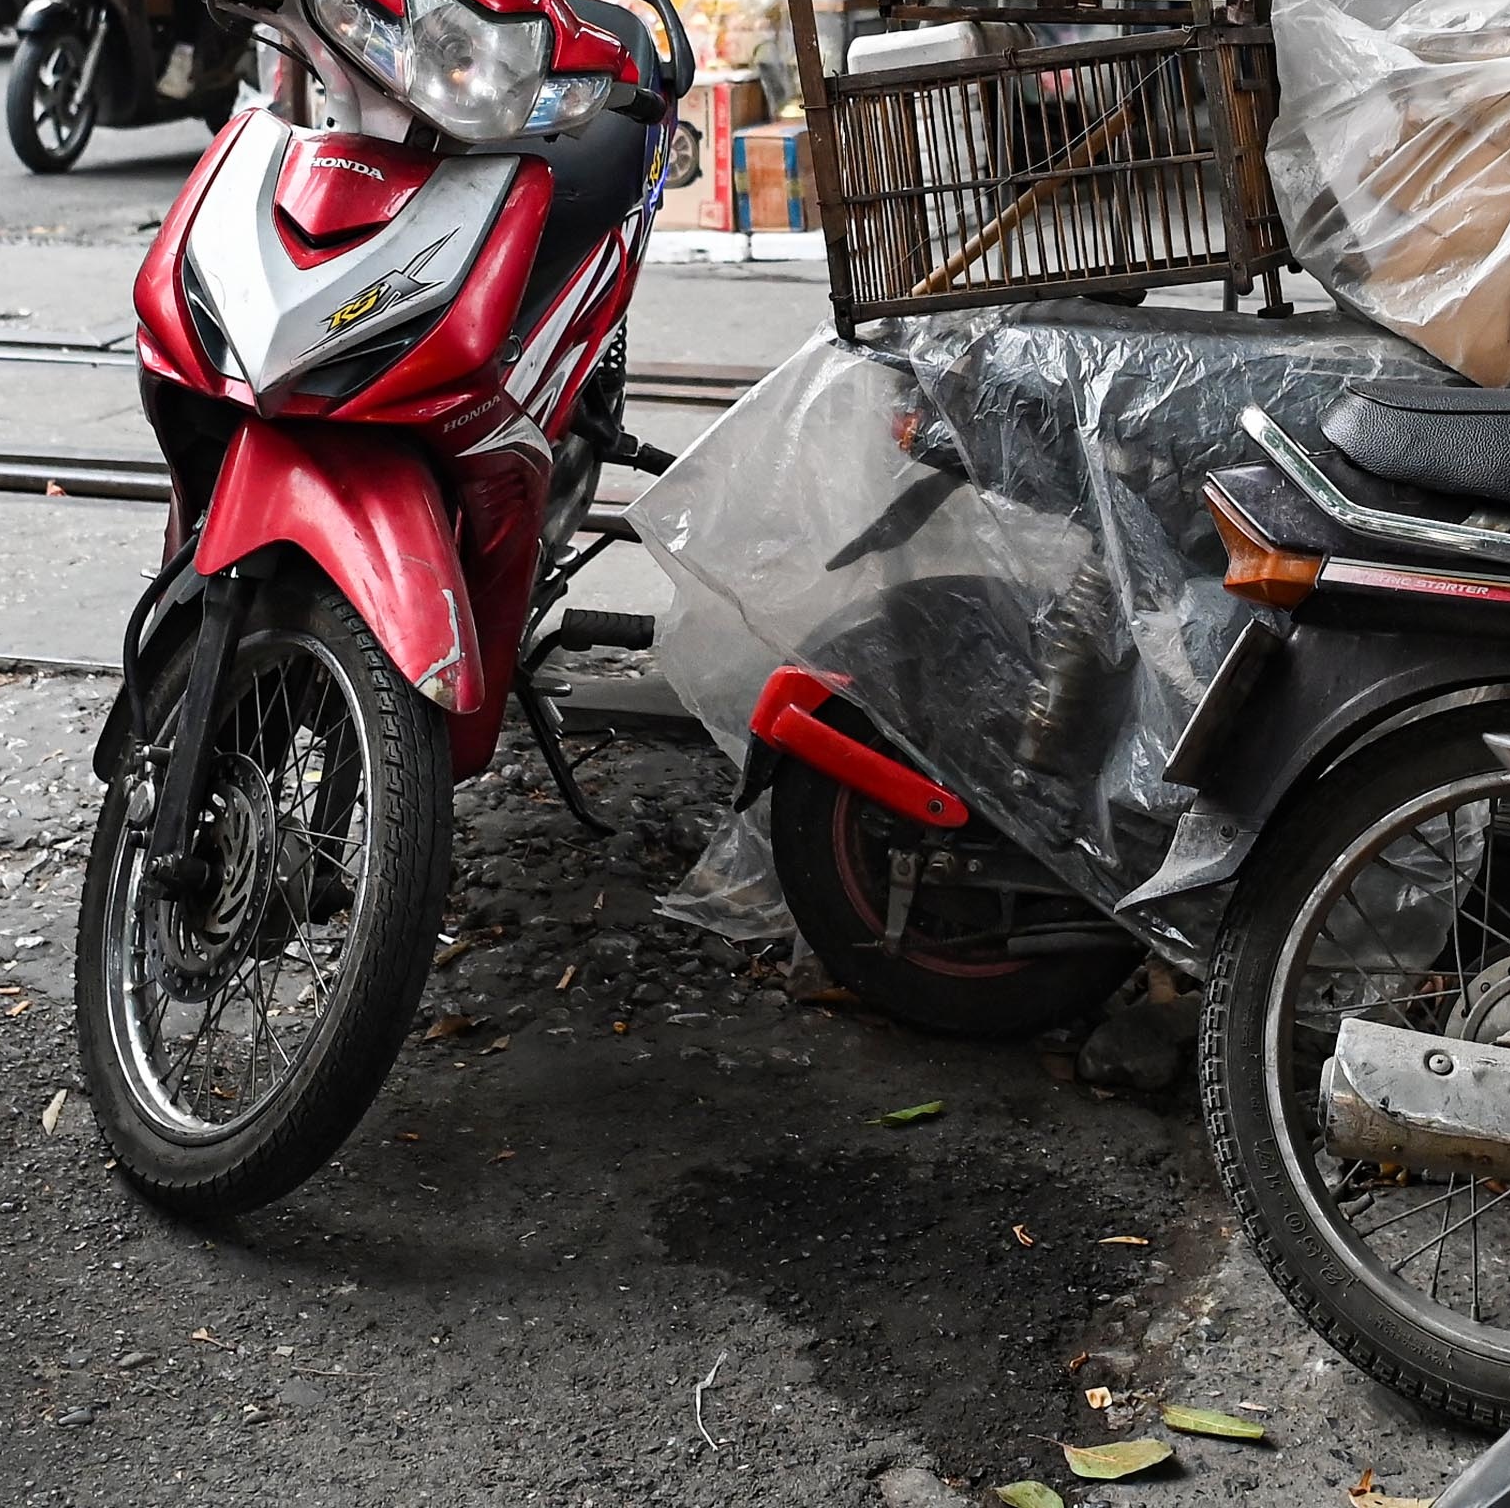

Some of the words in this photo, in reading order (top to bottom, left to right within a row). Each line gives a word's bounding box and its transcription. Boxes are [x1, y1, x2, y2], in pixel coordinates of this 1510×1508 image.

[310, 157, 385, 182] HONDA
[443, 395, 501, 433] HONDA
[1415, 580, 1489, 595] STARTER
